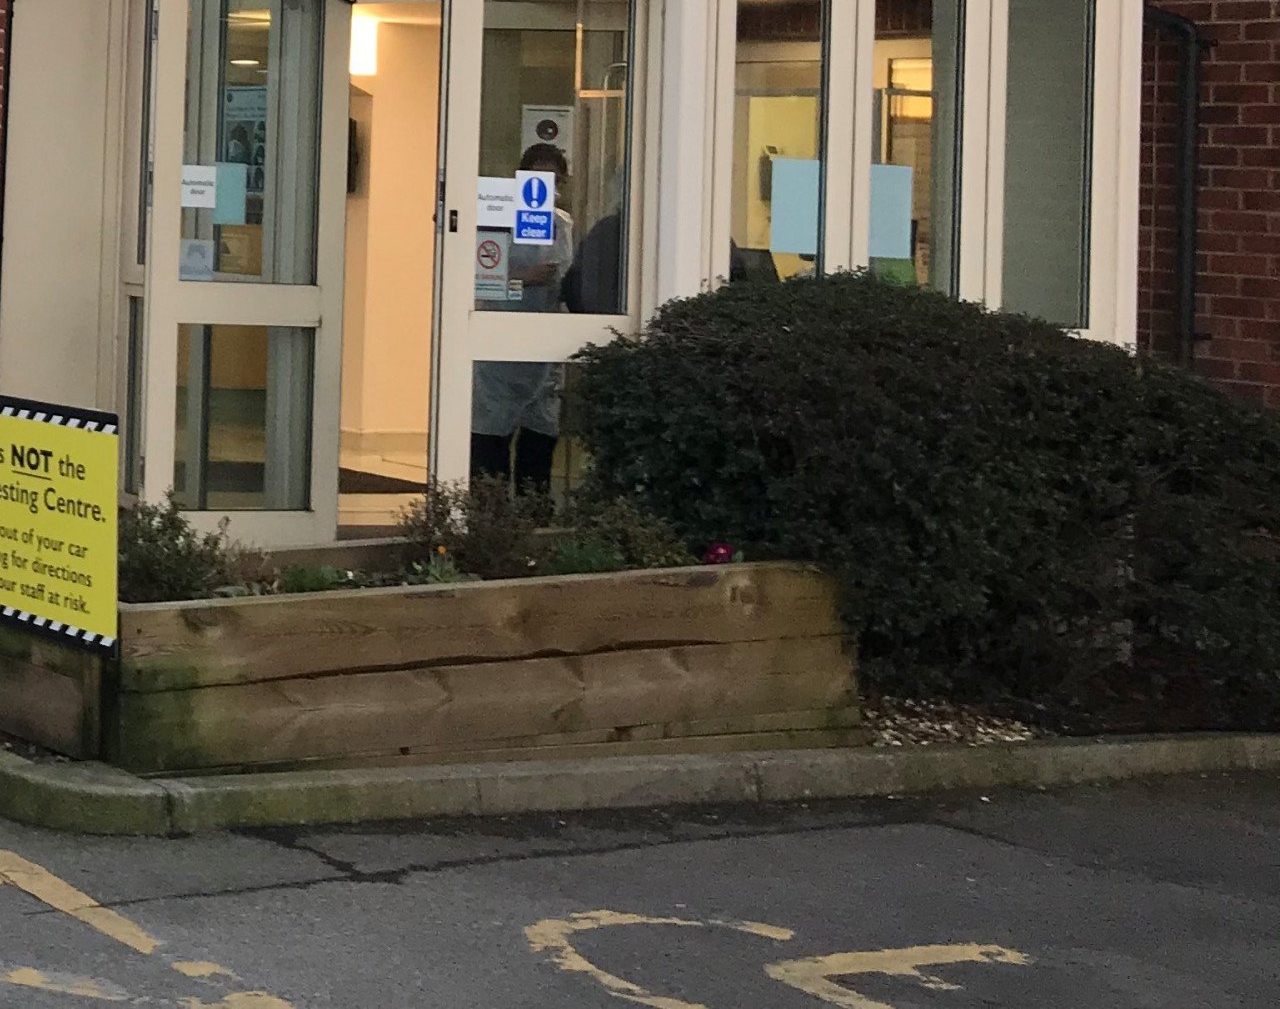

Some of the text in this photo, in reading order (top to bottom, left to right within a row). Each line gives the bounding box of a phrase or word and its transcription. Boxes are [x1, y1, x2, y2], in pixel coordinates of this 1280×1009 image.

[520, 226, 547, 239] clear
[521, 212, 548, 226] Keep
[10, 443, 53, 474] NOT
[58, 454, 87, 481] the
[43, 487, 107, 524] Centre.
[21, 527, 35, 545] of
[36, 534, 65, 553] your
[67, 542, 89, 559] car
[11, 549, 29, 570] for
[31, 556, 93, 588] directions
[19, 582, 46, 602] staff
[47, 590, 61, 608] at
[63, 593, 92, 615] risk.
